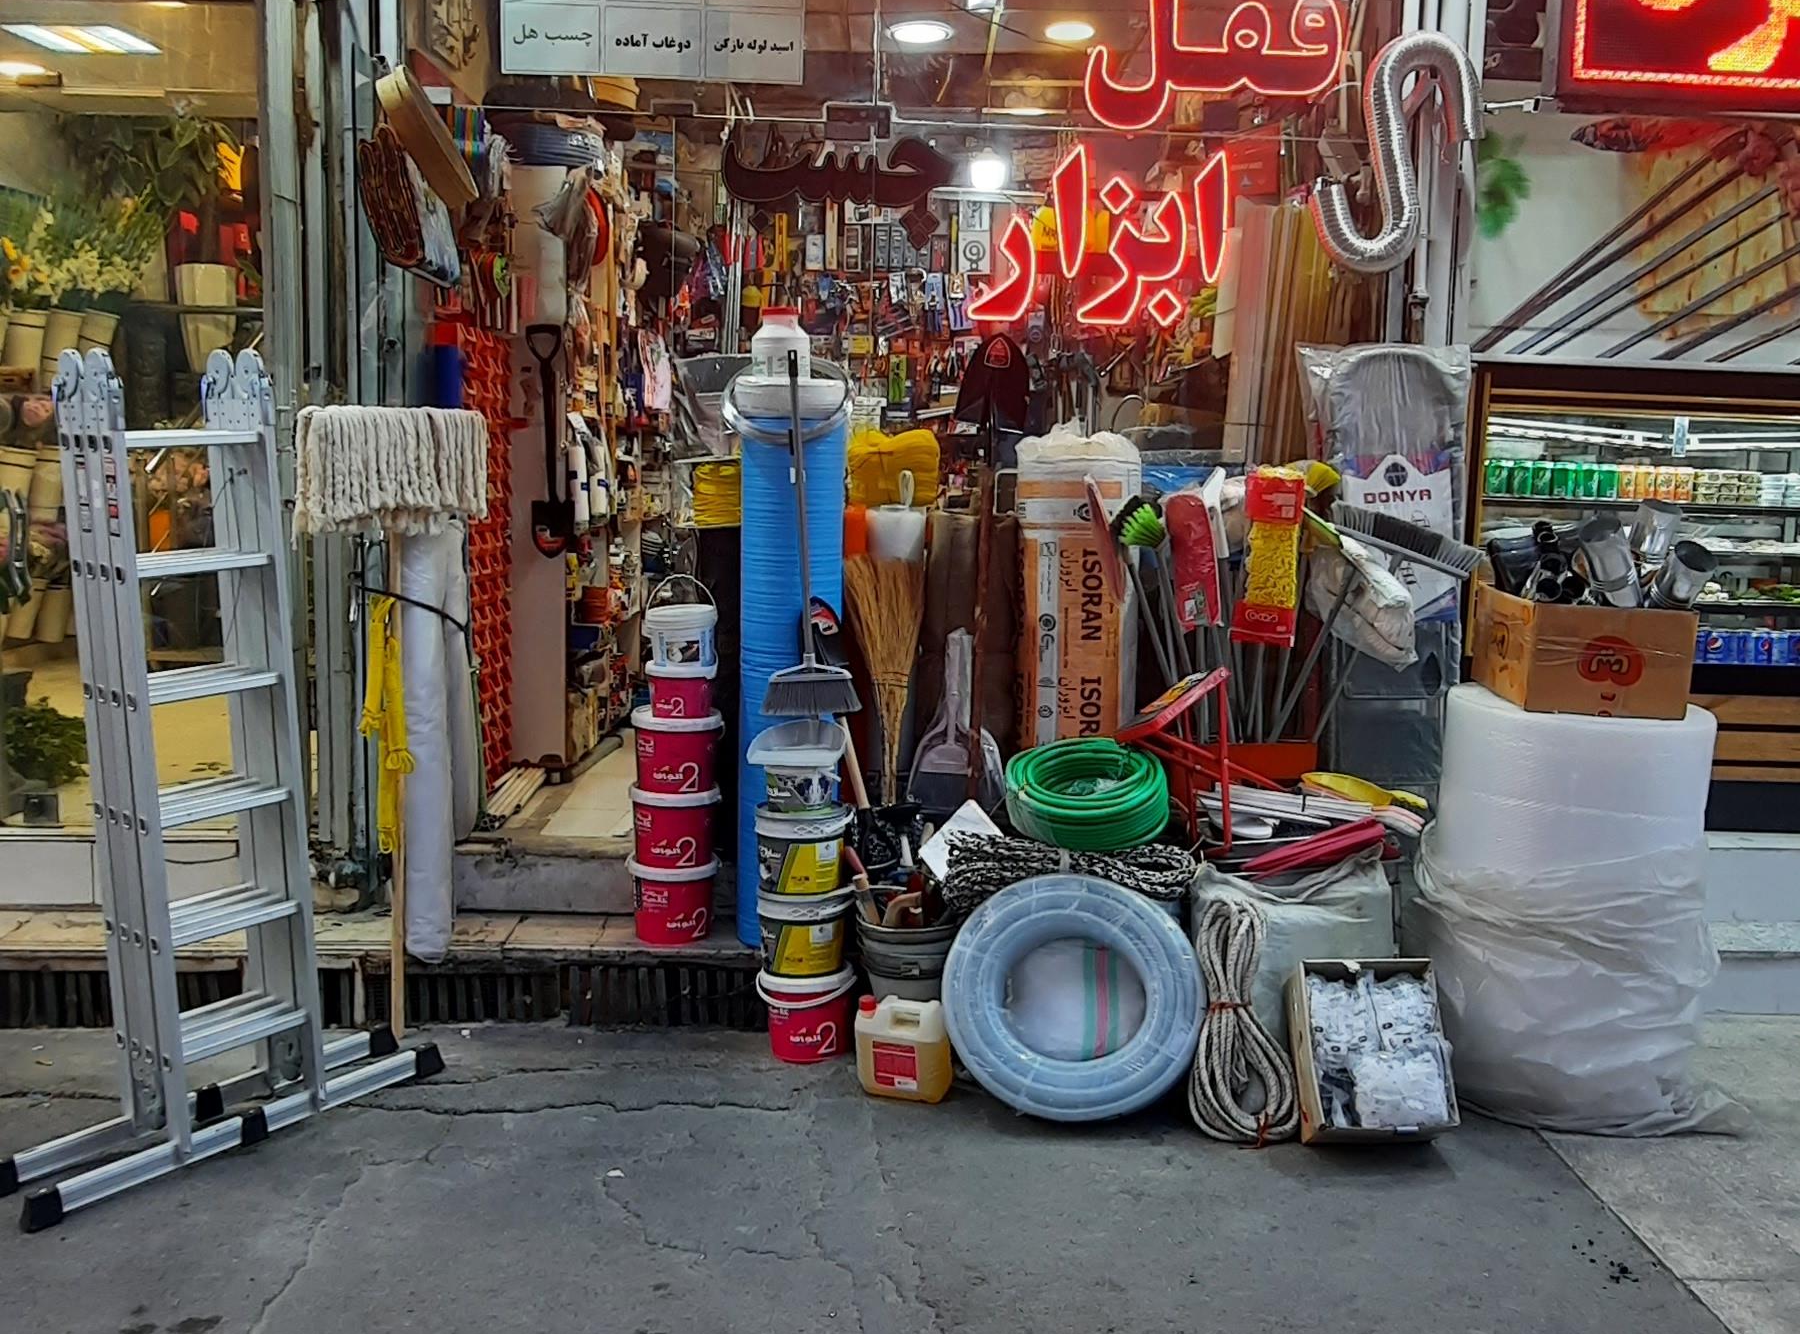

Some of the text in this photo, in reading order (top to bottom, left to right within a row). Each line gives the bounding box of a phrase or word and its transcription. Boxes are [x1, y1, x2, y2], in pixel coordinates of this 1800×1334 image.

[512, 23, 593, 48] چسب هل
[615, 33, 692, 54] دوغاب آماده
[747, 39, 768, 55] لوله
[769, 40, 794, 53] اسید
[721, 136, 955, 252] چسب
[968, 144, 1231, 328] ابزار
[1363, 487, 1432, 505] DONYA
[1081, 549, 1104, 641] ISORAN
